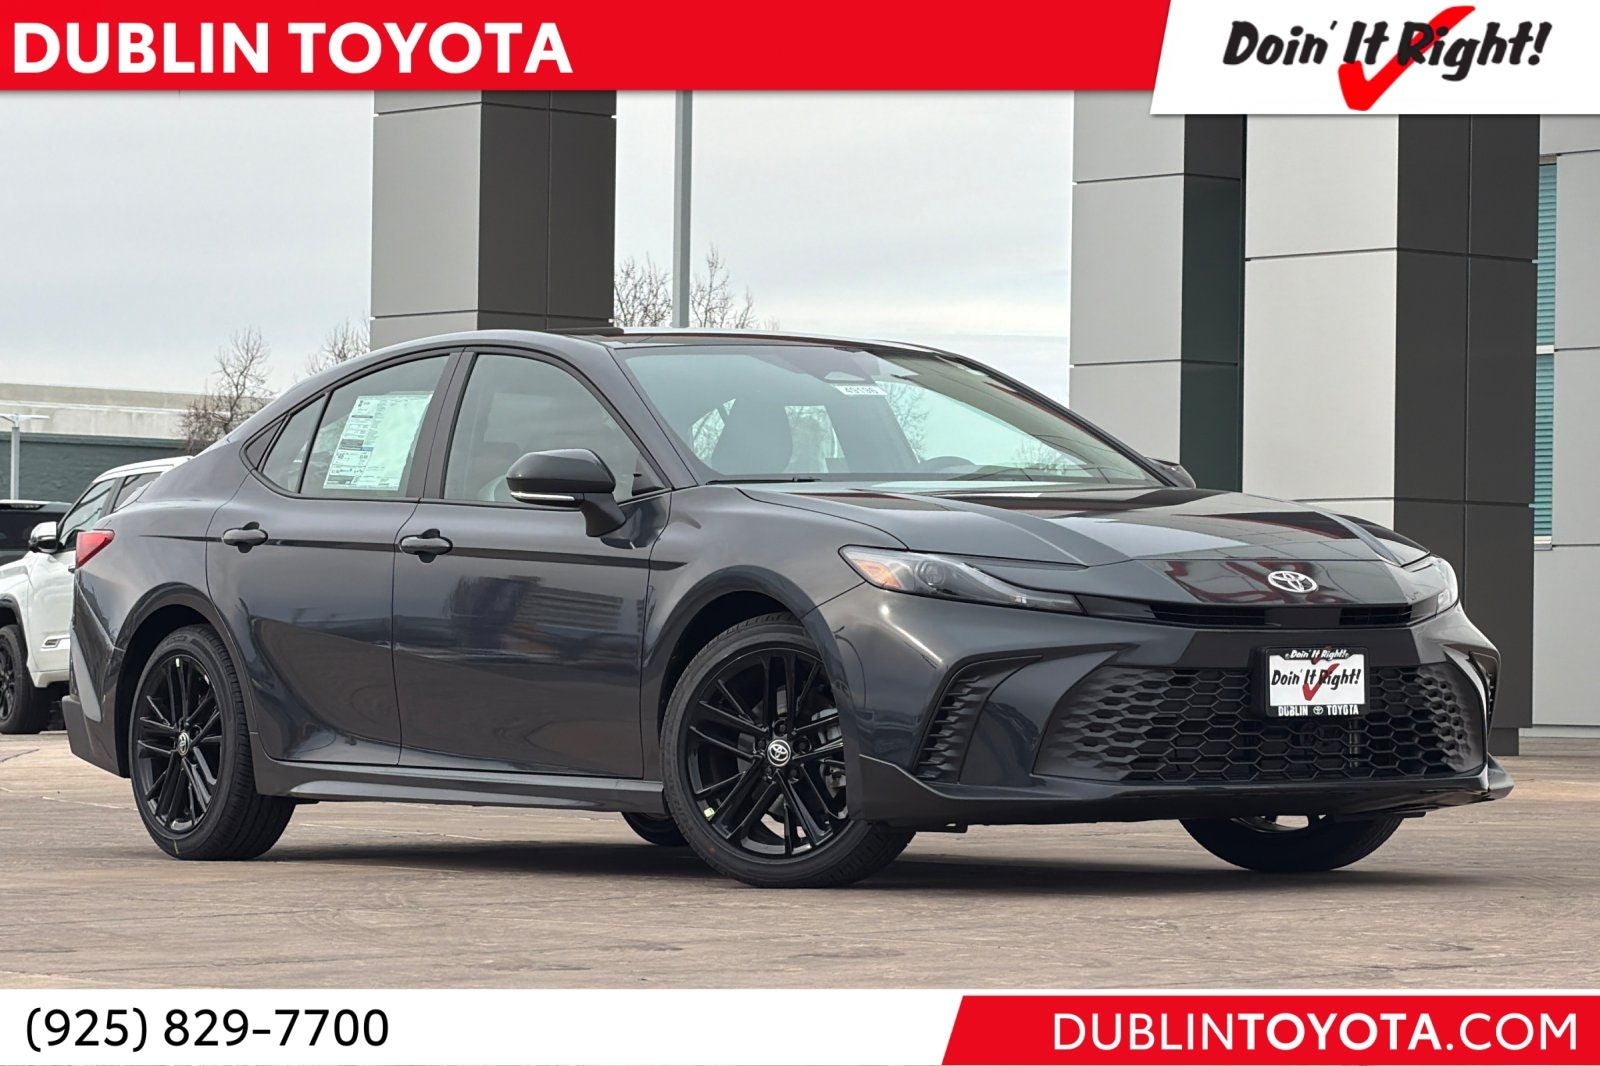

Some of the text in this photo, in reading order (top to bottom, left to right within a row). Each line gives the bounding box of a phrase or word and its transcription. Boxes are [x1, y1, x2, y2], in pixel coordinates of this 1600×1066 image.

[1311, 649, 1321, 658] It
[1321, 649, 1347, 661] Right!
[1271, 668, 1362, 691] Doin' It Right!
[1278, 704, 1359, 717] DUBLIN TOYOTA
